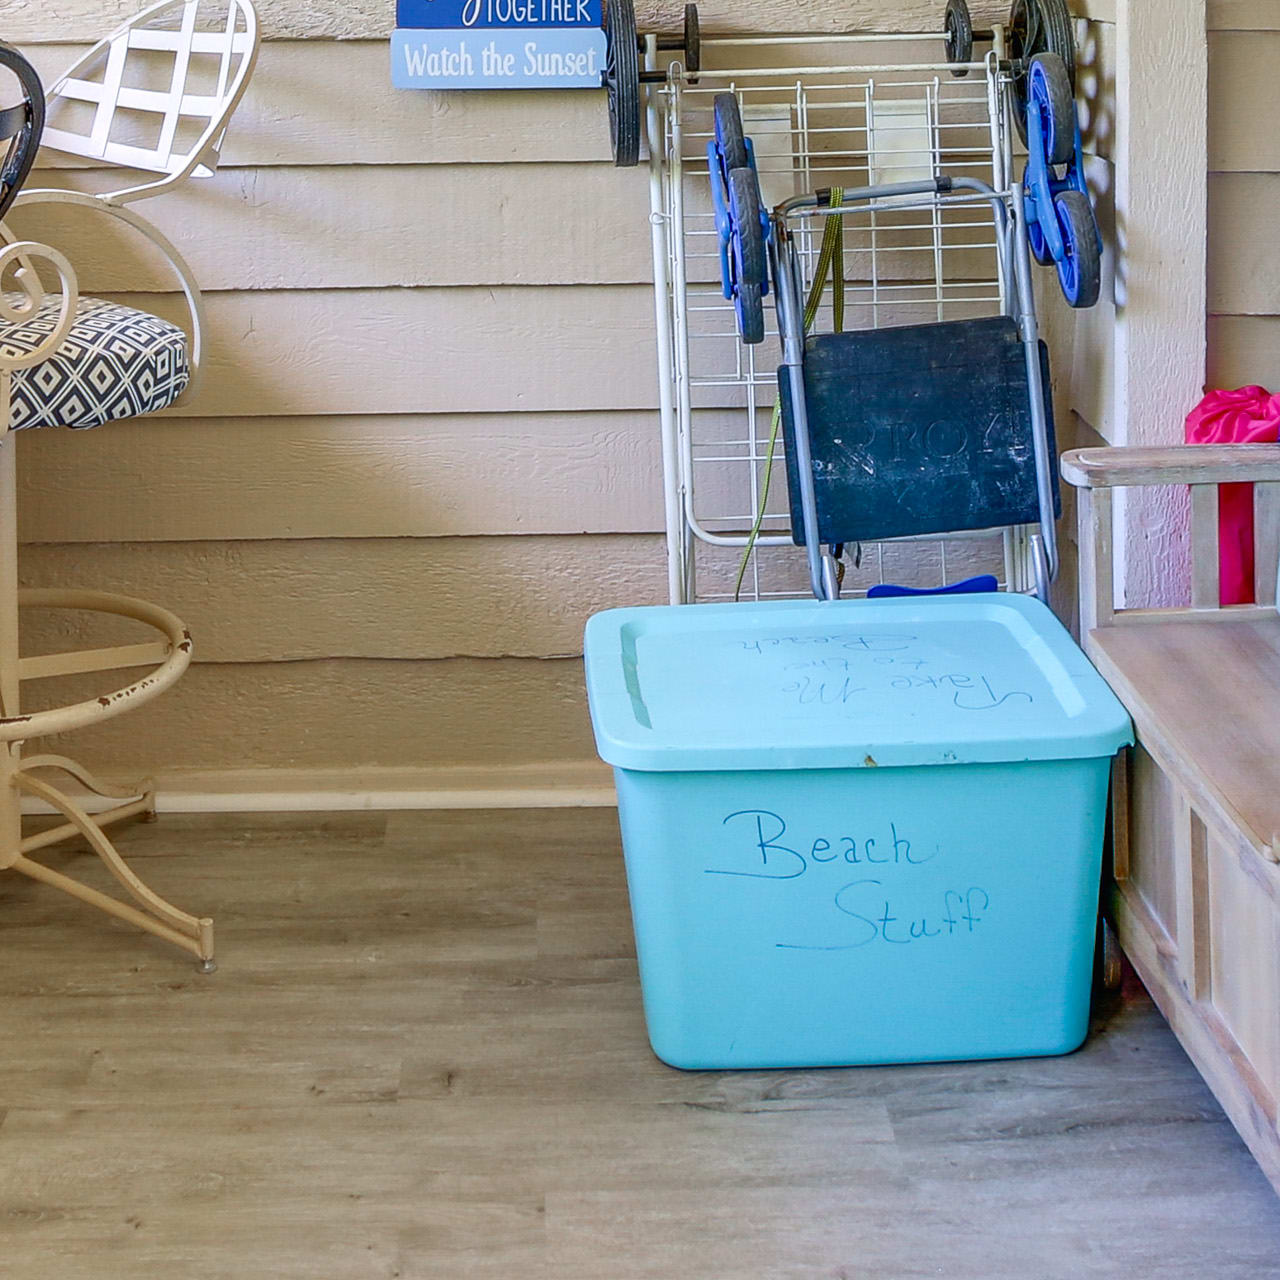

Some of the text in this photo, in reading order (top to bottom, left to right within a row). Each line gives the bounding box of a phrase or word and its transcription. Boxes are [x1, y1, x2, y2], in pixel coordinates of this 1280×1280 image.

[404, 41, 597, 77] Watch the Sunset
[891, 674, 1032, 710] Take
[704, 810, 939, 879] Beach
[776, 879, 989, 950] Stuff
